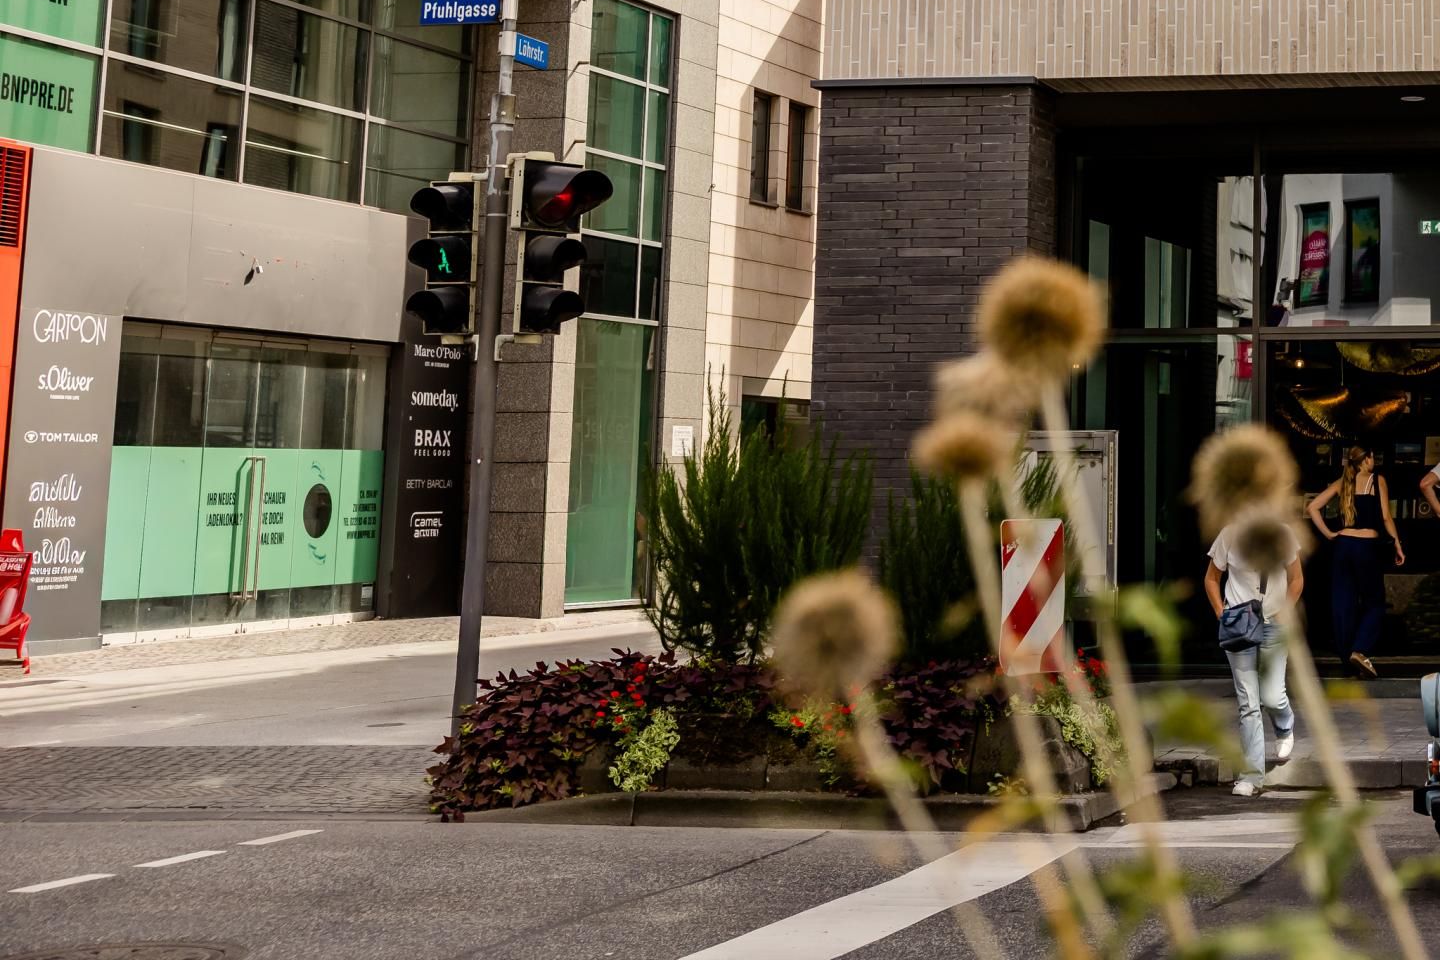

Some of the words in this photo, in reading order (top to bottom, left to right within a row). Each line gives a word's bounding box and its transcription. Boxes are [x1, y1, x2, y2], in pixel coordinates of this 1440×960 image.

[423, 1, 496, 22] Pfuhlgasse
[518, 39, 545, 63] Löhrstr.
[1, 72, 75, 115] BNPPRE.DE
[414, 344, 435, 357] Marc
[436, 346, 461, 360] O'Polo
[38, 365, 94, 391] s.Oliver
[411, 389, 459, 412] someday.
[40, 432, 62, 442] TOM
[63, 433, 98, 443] TAILOR
[414, 429, 451, 447] BRAX
[406, 479, 426, 489] BETTY
[206, 492, 217, 506] IHR
[264, 492, 286, 505] CHAUEN
